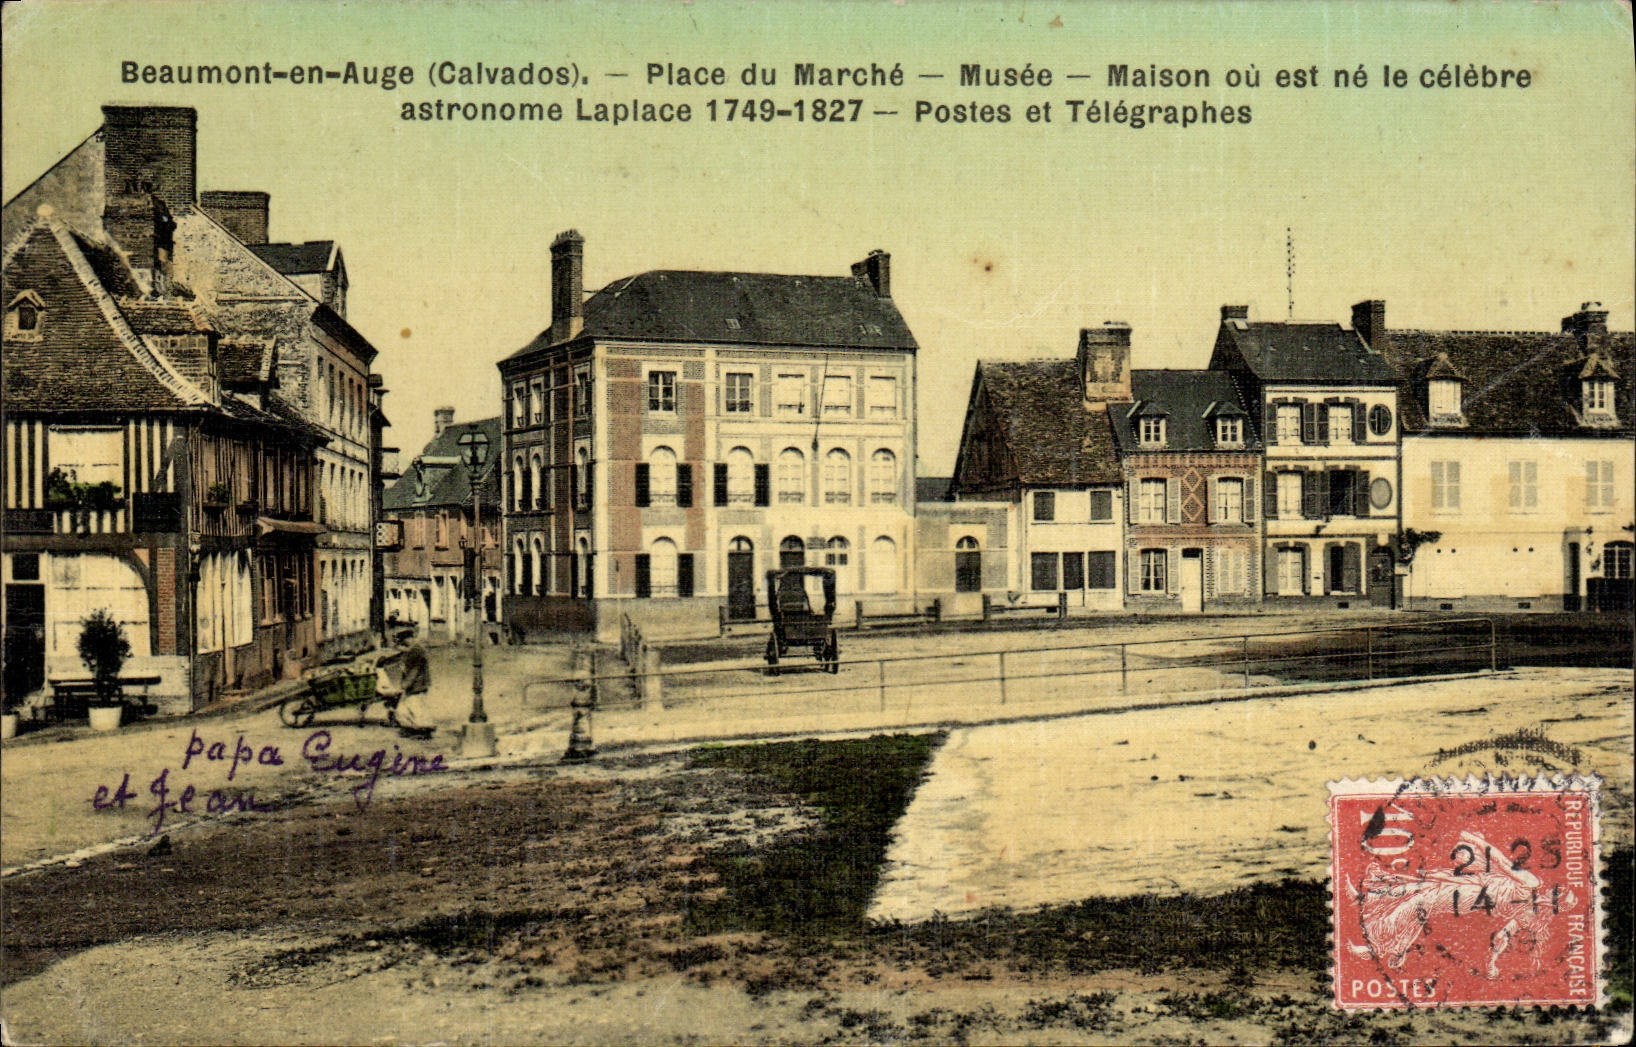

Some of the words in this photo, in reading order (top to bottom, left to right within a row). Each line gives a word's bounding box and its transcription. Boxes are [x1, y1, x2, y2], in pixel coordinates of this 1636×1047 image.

[183, 728, 284, 781] papa
[92, 773, 138, 810] et
[147, 768, 276, 836] Jean
[1351, 978, 1437, 999] POSTES
